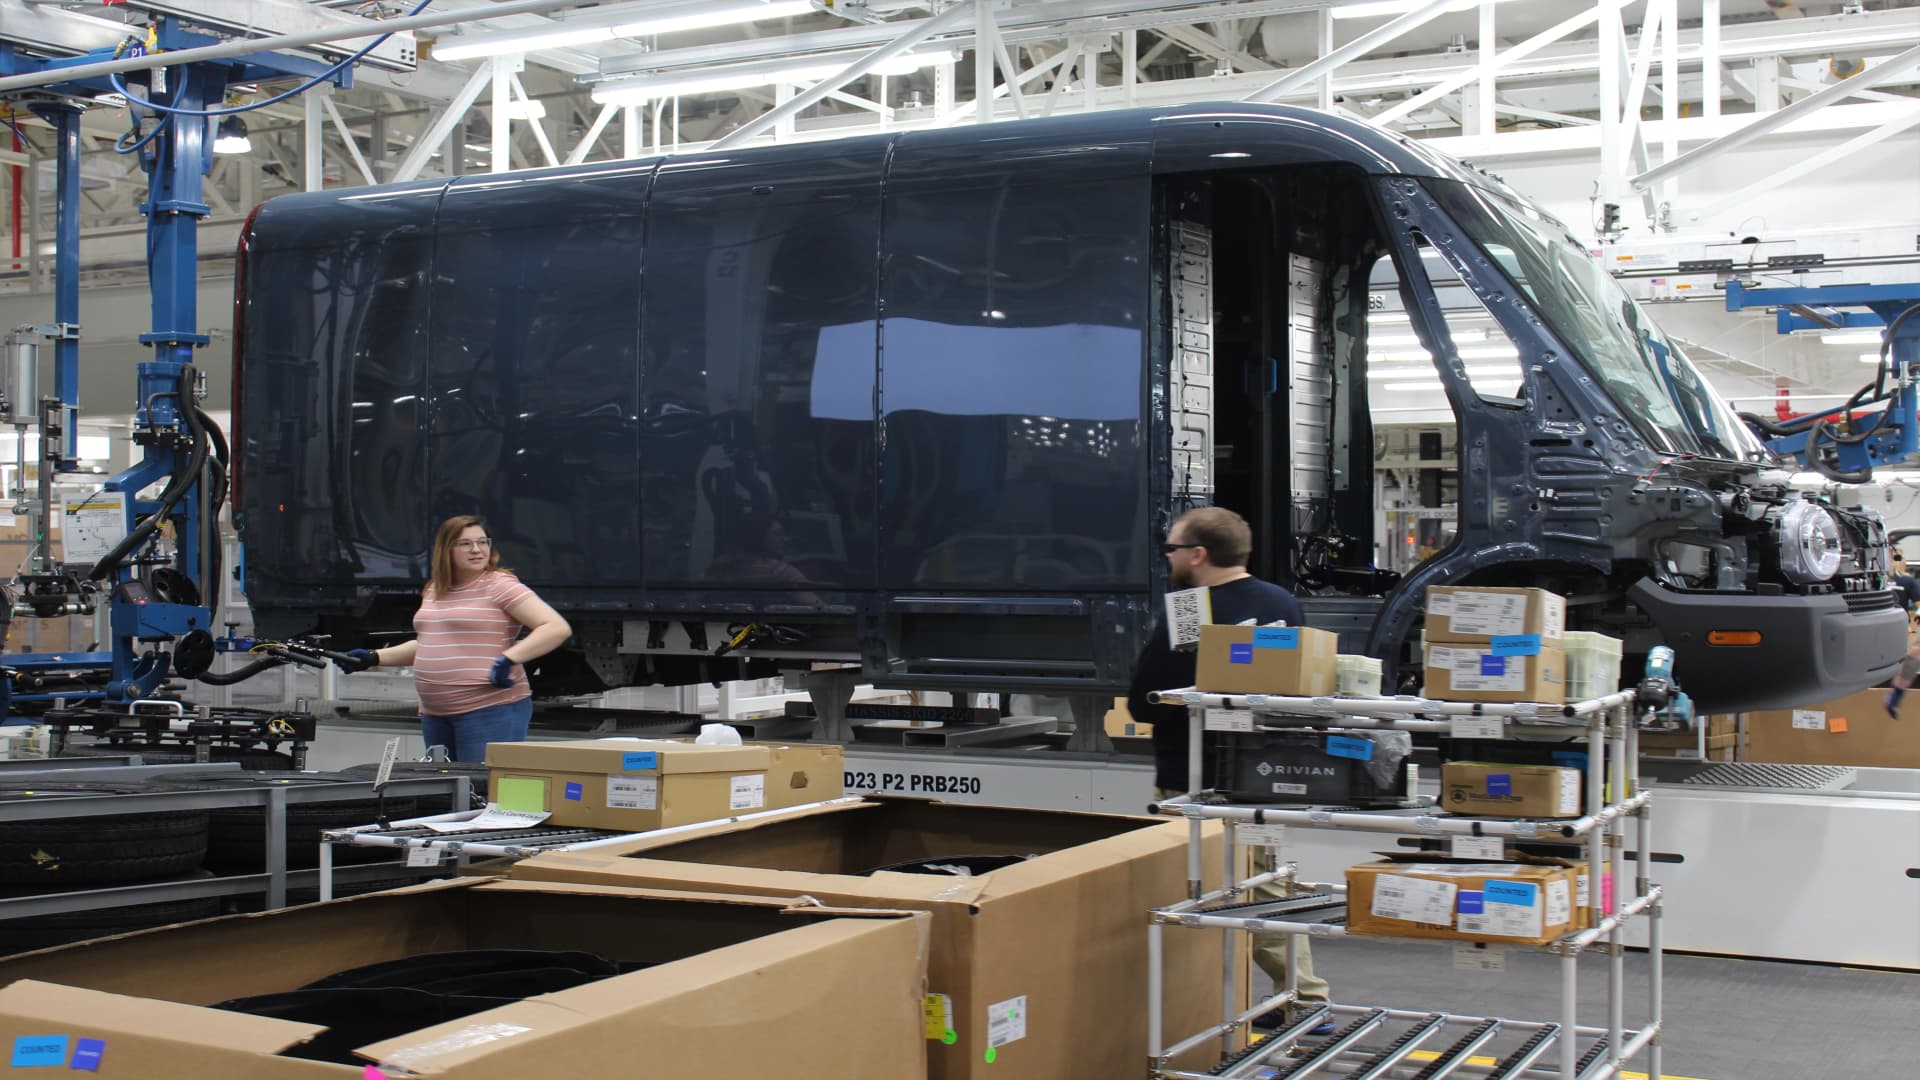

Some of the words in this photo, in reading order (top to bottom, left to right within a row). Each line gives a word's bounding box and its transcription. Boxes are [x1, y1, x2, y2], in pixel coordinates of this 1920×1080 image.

[131, 46, 143, 59] P1
[1275, 764, 1336, 777] RIVIAN
[882, 773, 905, 791] P2
[910, 774, 982, 795] PRB250
[1488, 885, 1529, 897] COUNTED
